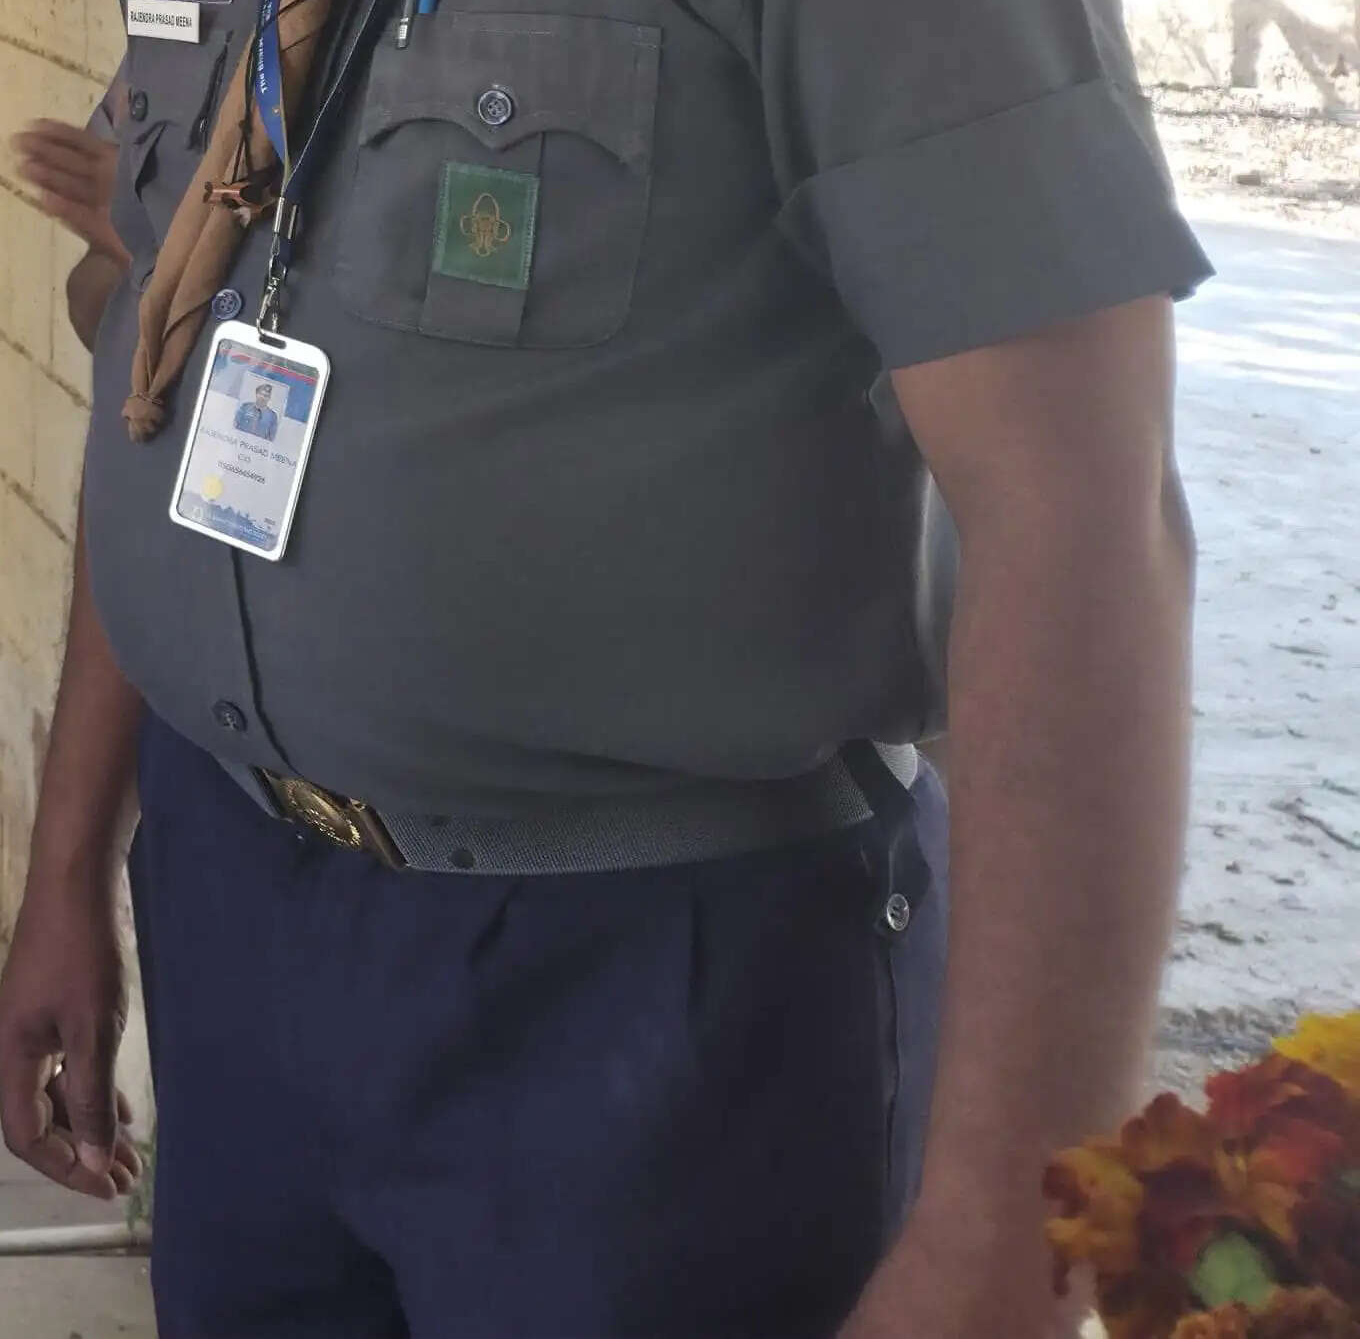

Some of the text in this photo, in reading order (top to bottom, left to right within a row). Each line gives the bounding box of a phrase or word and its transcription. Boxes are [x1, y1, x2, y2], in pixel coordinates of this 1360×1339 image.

[130, 11, 192, 28] RAJENDRA PRASAD MEENA
[259, 72, 268, 94] The
